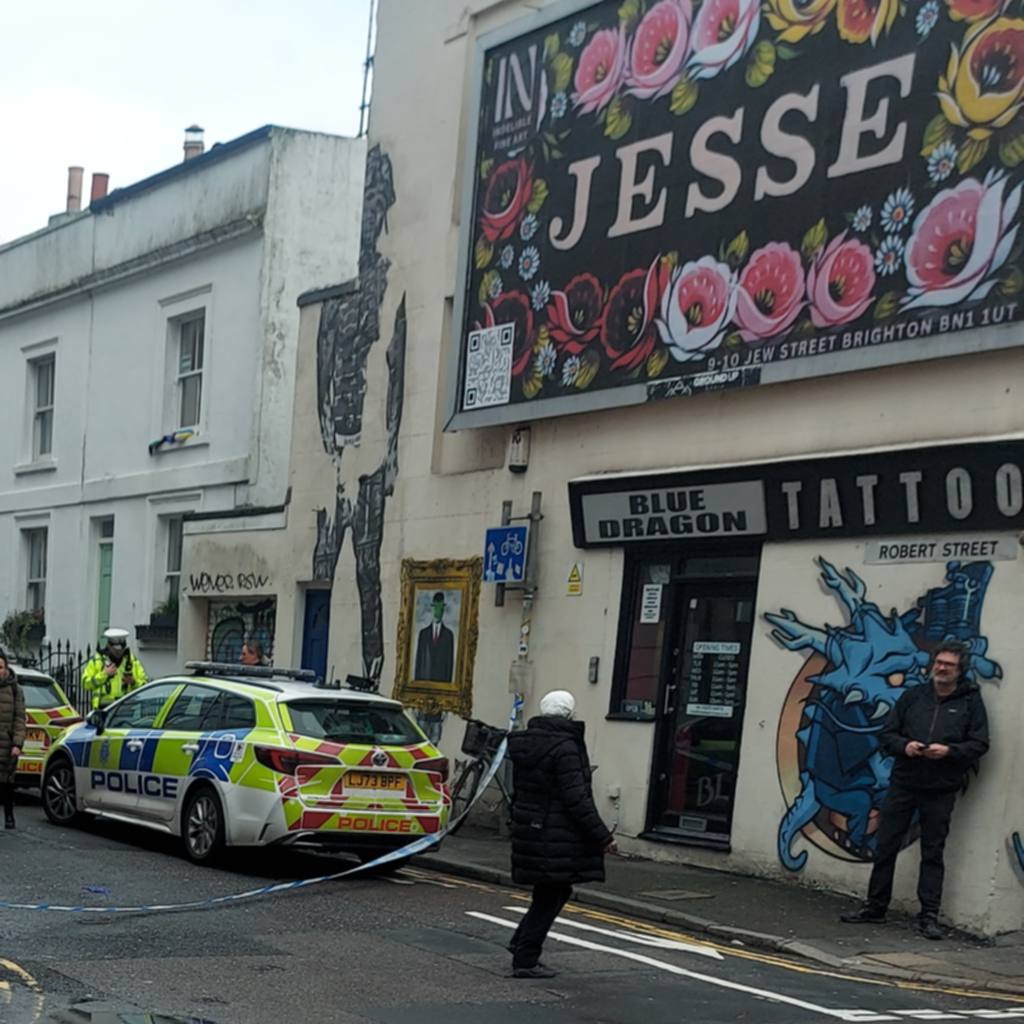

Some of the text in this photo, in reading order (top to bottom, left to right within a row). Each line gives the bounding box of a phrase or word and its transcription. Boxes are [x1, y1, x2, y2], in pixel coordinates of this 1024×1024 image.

[494, 44, 537, 123] IN
[548, 52, 917, 250] JESSE
[708, 302, 1018, 372] 9-10 JEW STREET BRIGHTON BN1 1UT
[629, 489, 707, 515] BLUE
[781, 463, 1024, 530] TATTOO
[598, 510, 747, 539] DRAGON
[879, 541, 999, 559] ROBERT STREET
[91, 770, 179, 798] POLICE
[338, 817, 412, 832] POLICE
